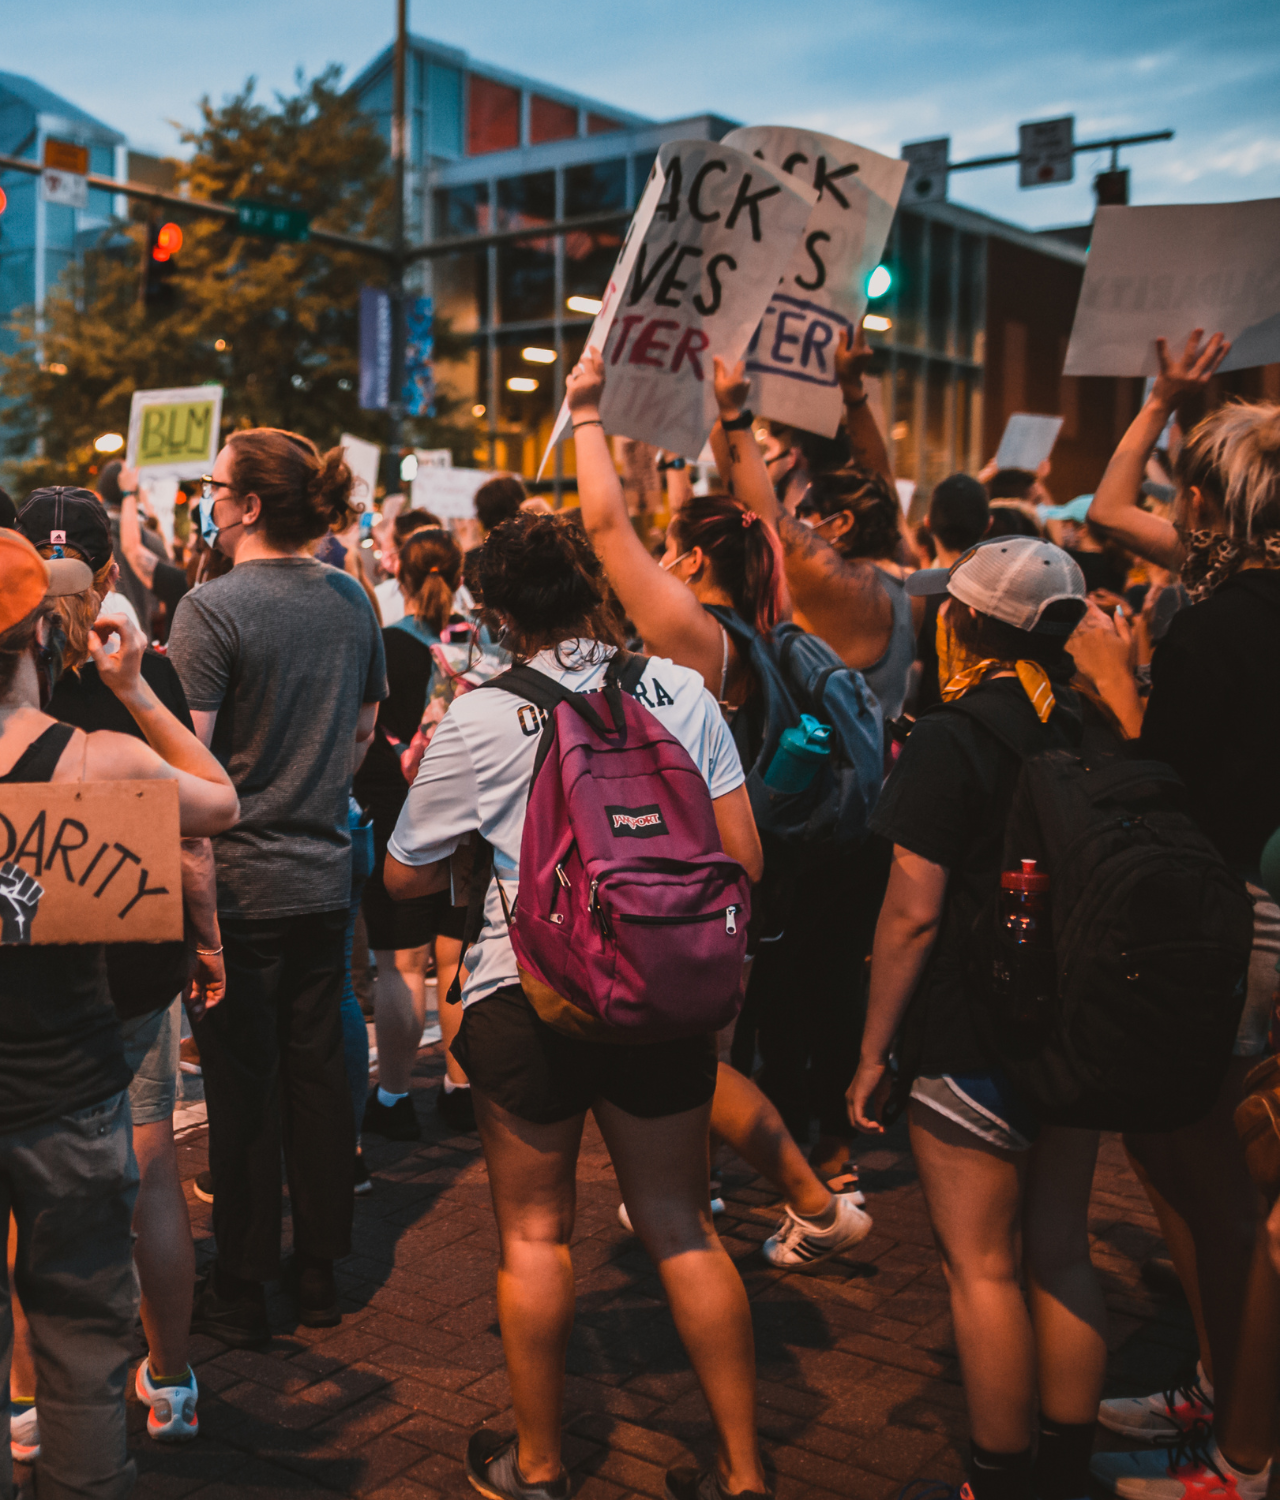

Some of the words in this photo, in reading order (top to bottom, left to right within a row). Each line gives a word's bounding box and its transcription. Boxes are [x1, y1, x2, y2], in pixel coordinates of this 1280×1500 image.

[652, 155, 782, 243] ACK
[626, 239, 738, 317] VES
[610, 314, 710, 382] TER
[141, 406, 211, 457] BLM
